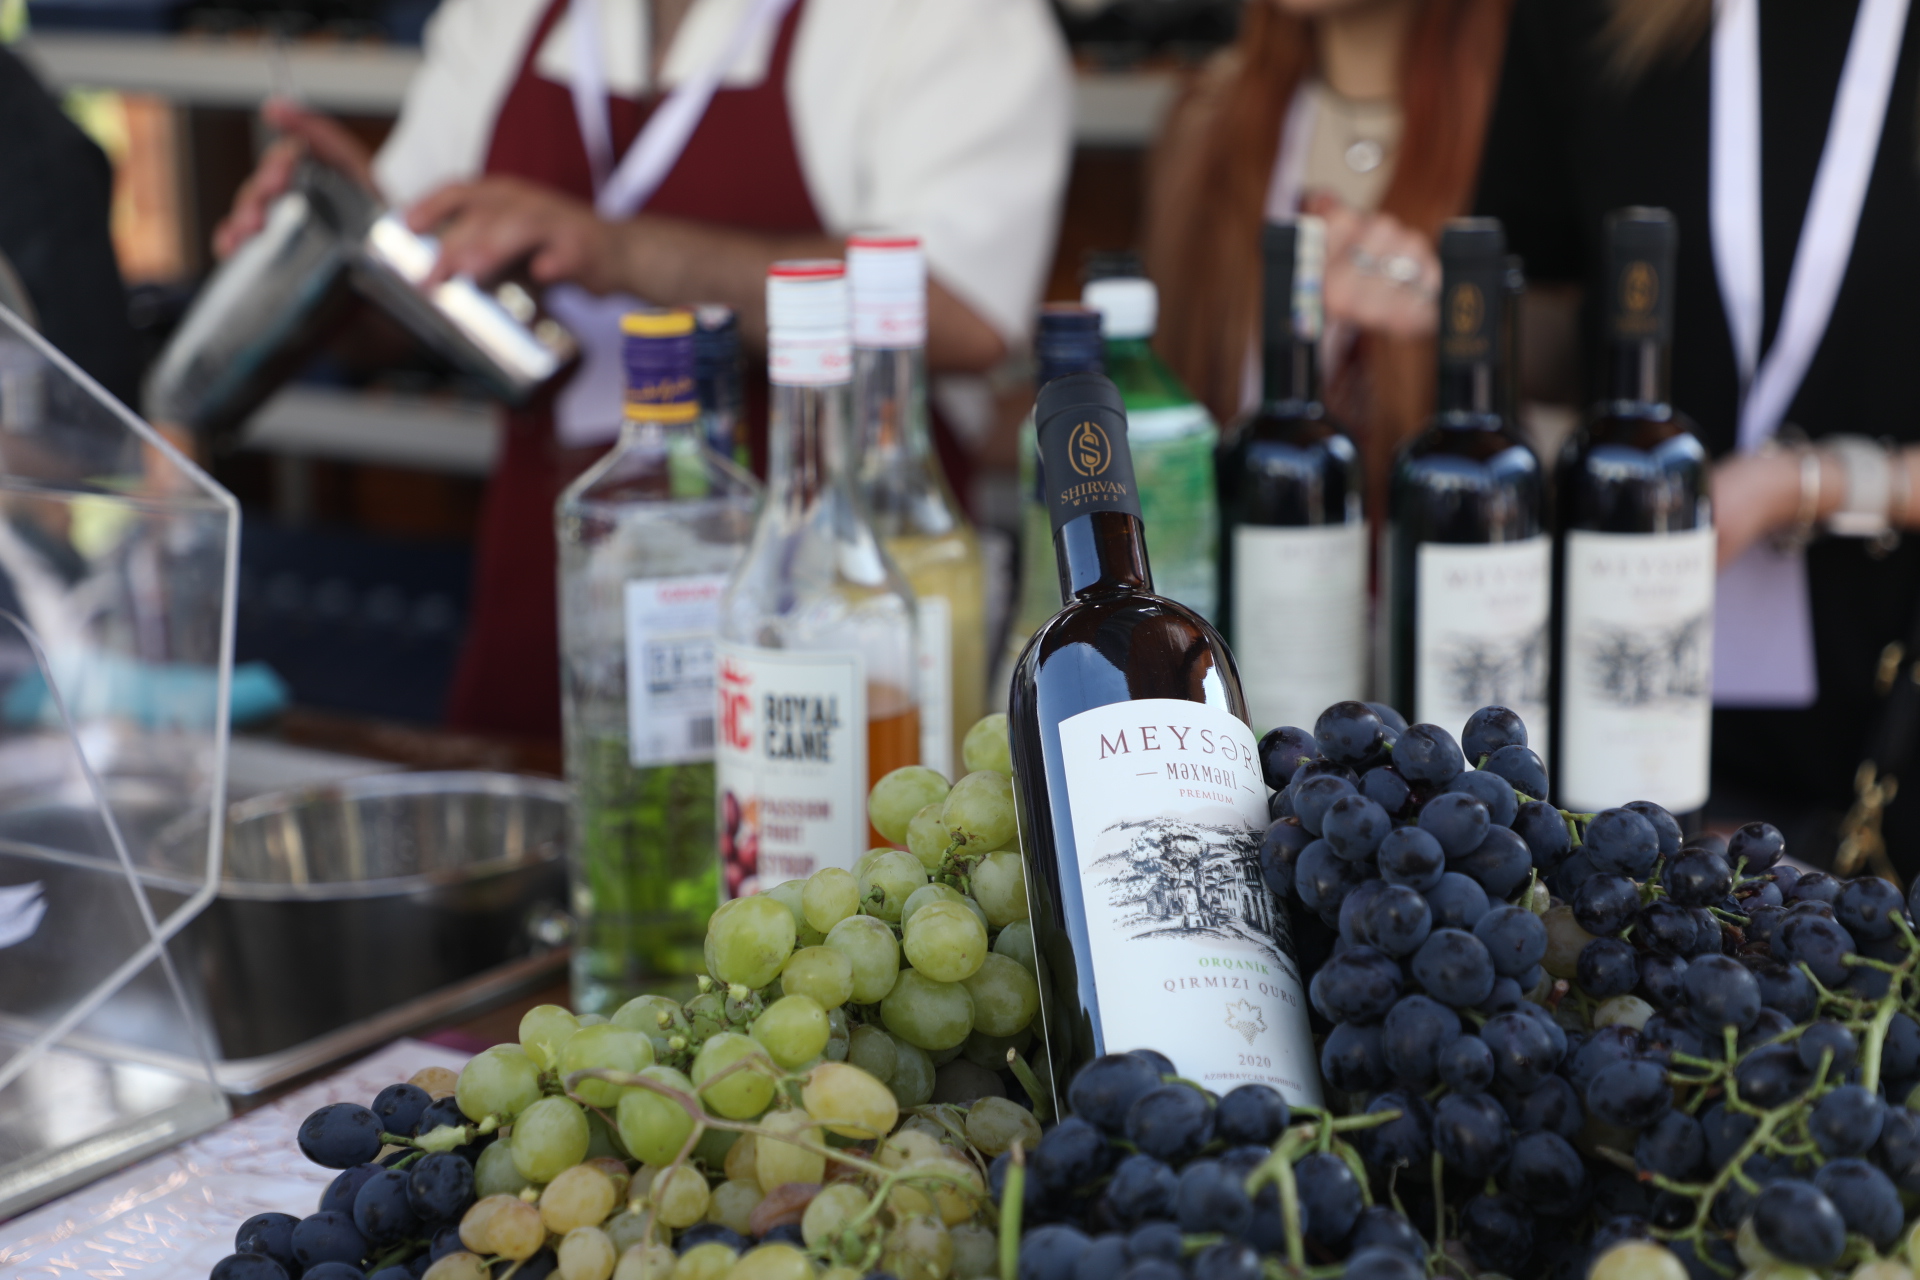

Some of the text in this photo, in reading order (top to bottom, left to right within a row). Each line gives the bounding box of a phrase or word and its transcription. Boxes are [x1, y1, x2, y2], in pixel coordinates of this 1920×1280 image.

[1060, 480, 1127, 505] SHIRVAN
[1073, 494, 1119, 507] WINES
[763, 693, 840, 728] ROYAL
[765, 727, 833, 763] CANE
[1198, 957, 1269, 975] ORQANİK
[1163, 976, 1297, 1007] QIRMIZI QURU
[1238, 1054, 1272, 1068] 2020
